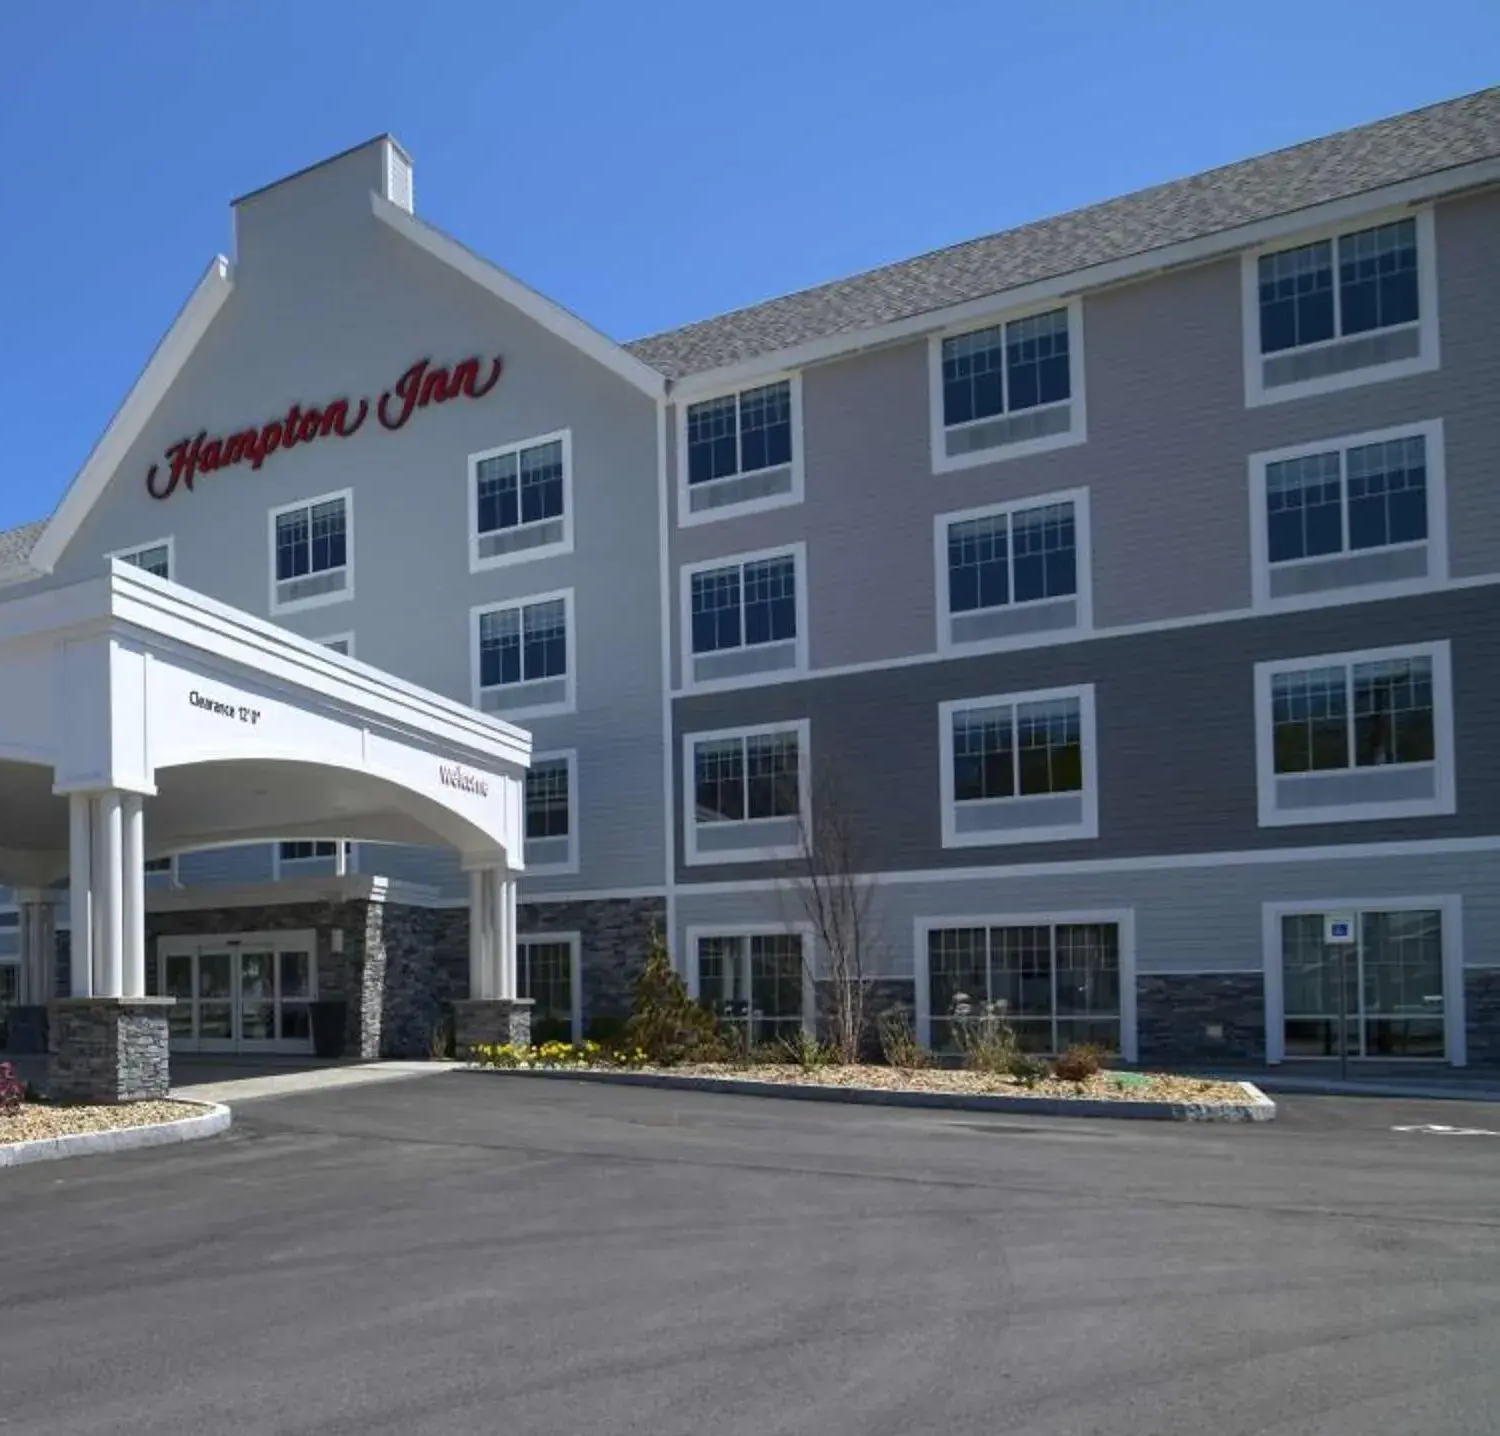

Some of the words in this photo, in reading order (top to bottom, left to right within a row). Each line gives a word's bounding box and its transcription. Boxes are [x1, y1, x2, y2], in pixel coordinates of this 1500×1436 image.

[146, 398, 368, 499] Hampton
[378, 353, 503, 430] Inn
[189, 690, 235, 719] Clearance
